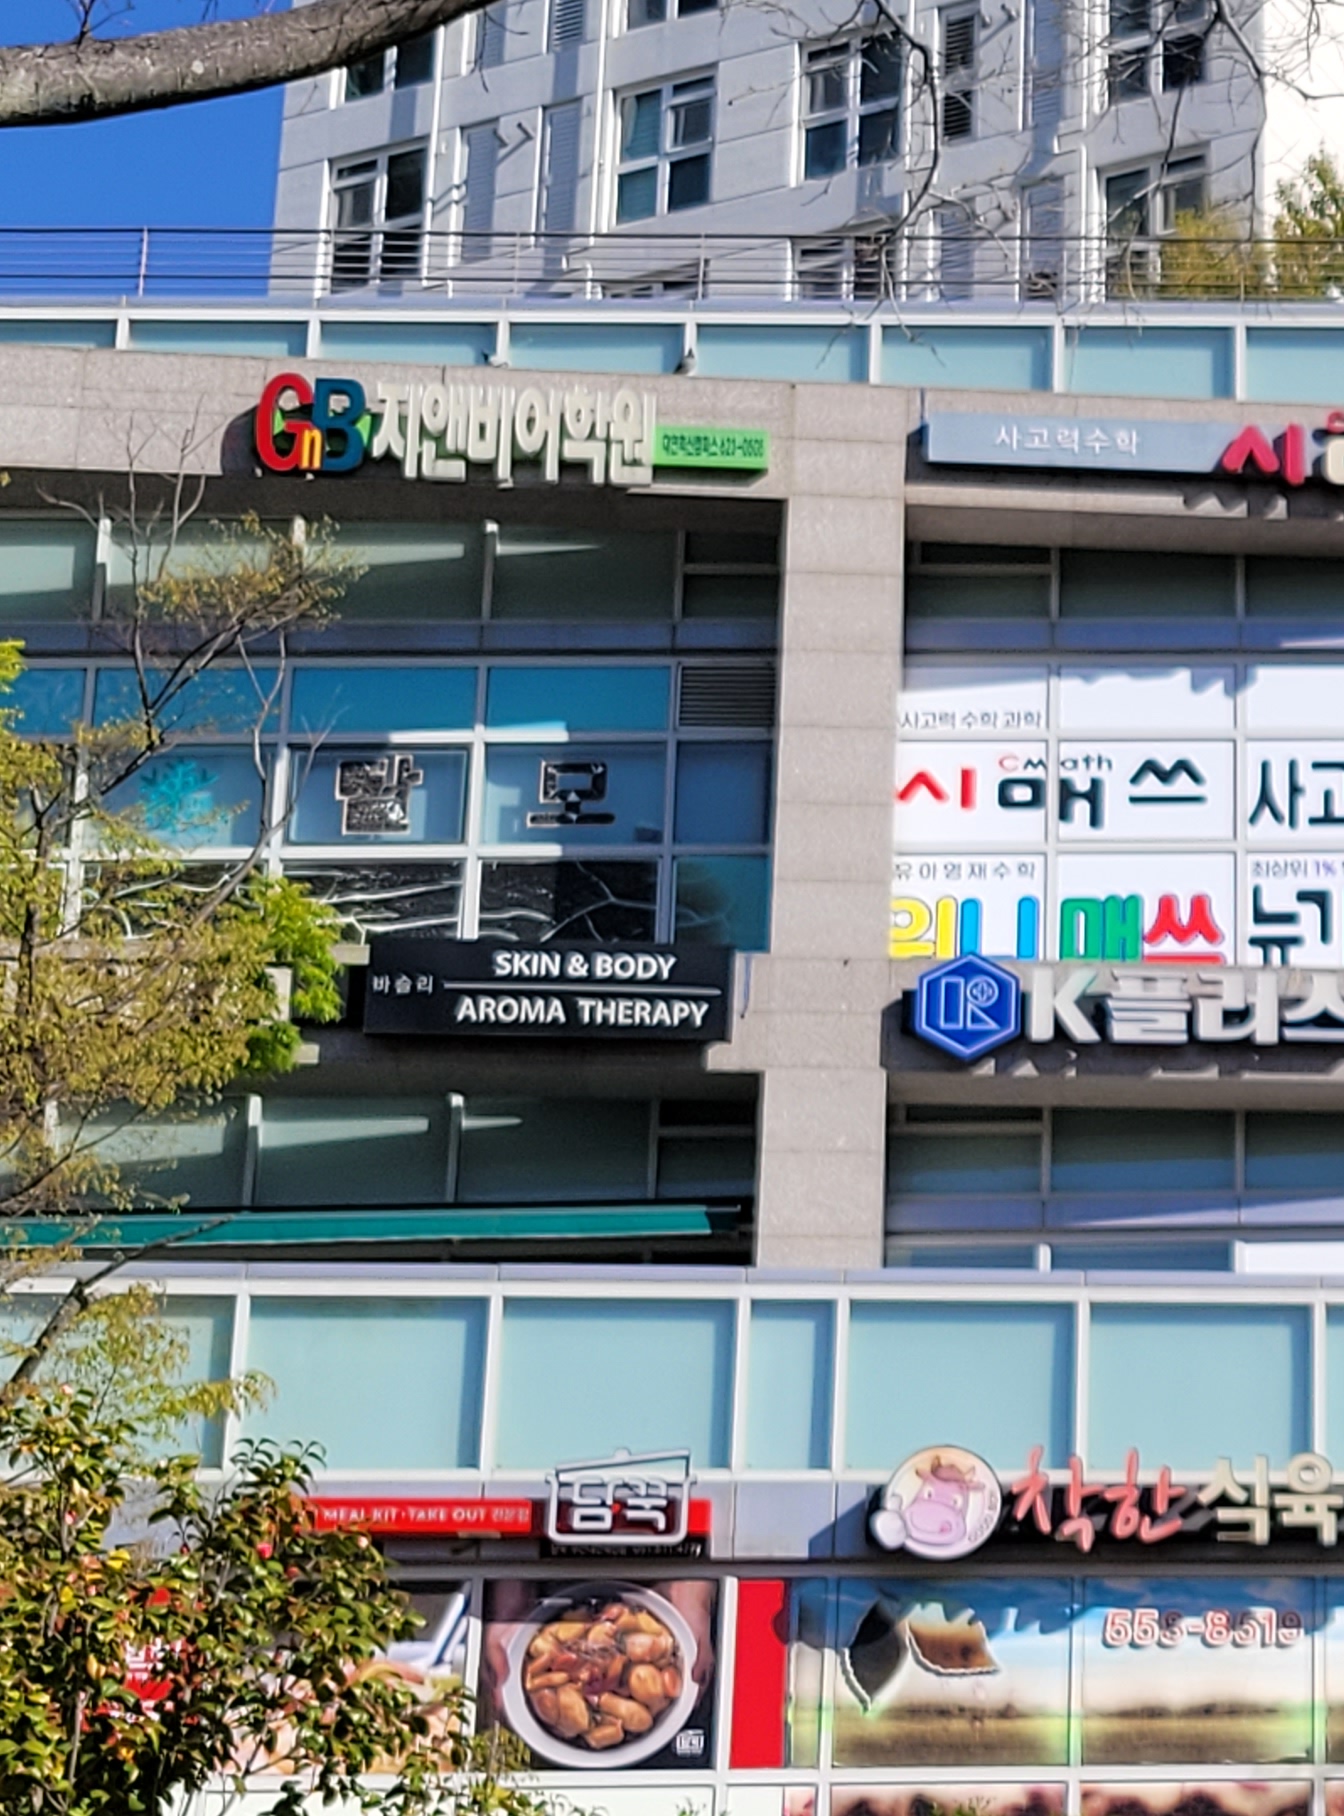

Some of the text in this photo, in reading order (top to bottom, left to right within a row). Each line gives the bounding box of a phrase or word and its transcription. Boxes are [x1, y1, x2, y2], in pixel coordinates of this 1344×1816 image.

[256, 371, 366, 473] GnB
[371, 382, 655, 486] 지앤비어학원
[993, 425, 1142, 457] 사고력수학
[900, 711, 956, 731] 사고력
[961, 711, 997, 730] 수학
[897, 758, 1207, 830] 시매쓰
[1314, 860, 1338, 876] 1%
[494, 952, 676, 981] SKIN & BODY
[373, 976, 434, 994] 바슬리
[455, 997, 709, 1028] AROMA THERAPY
[1012, 1446, 1188, 1553] 착한
[324, 1508, 366, 1523] MEAL
[452, 1509, 487, 1523] OUT
